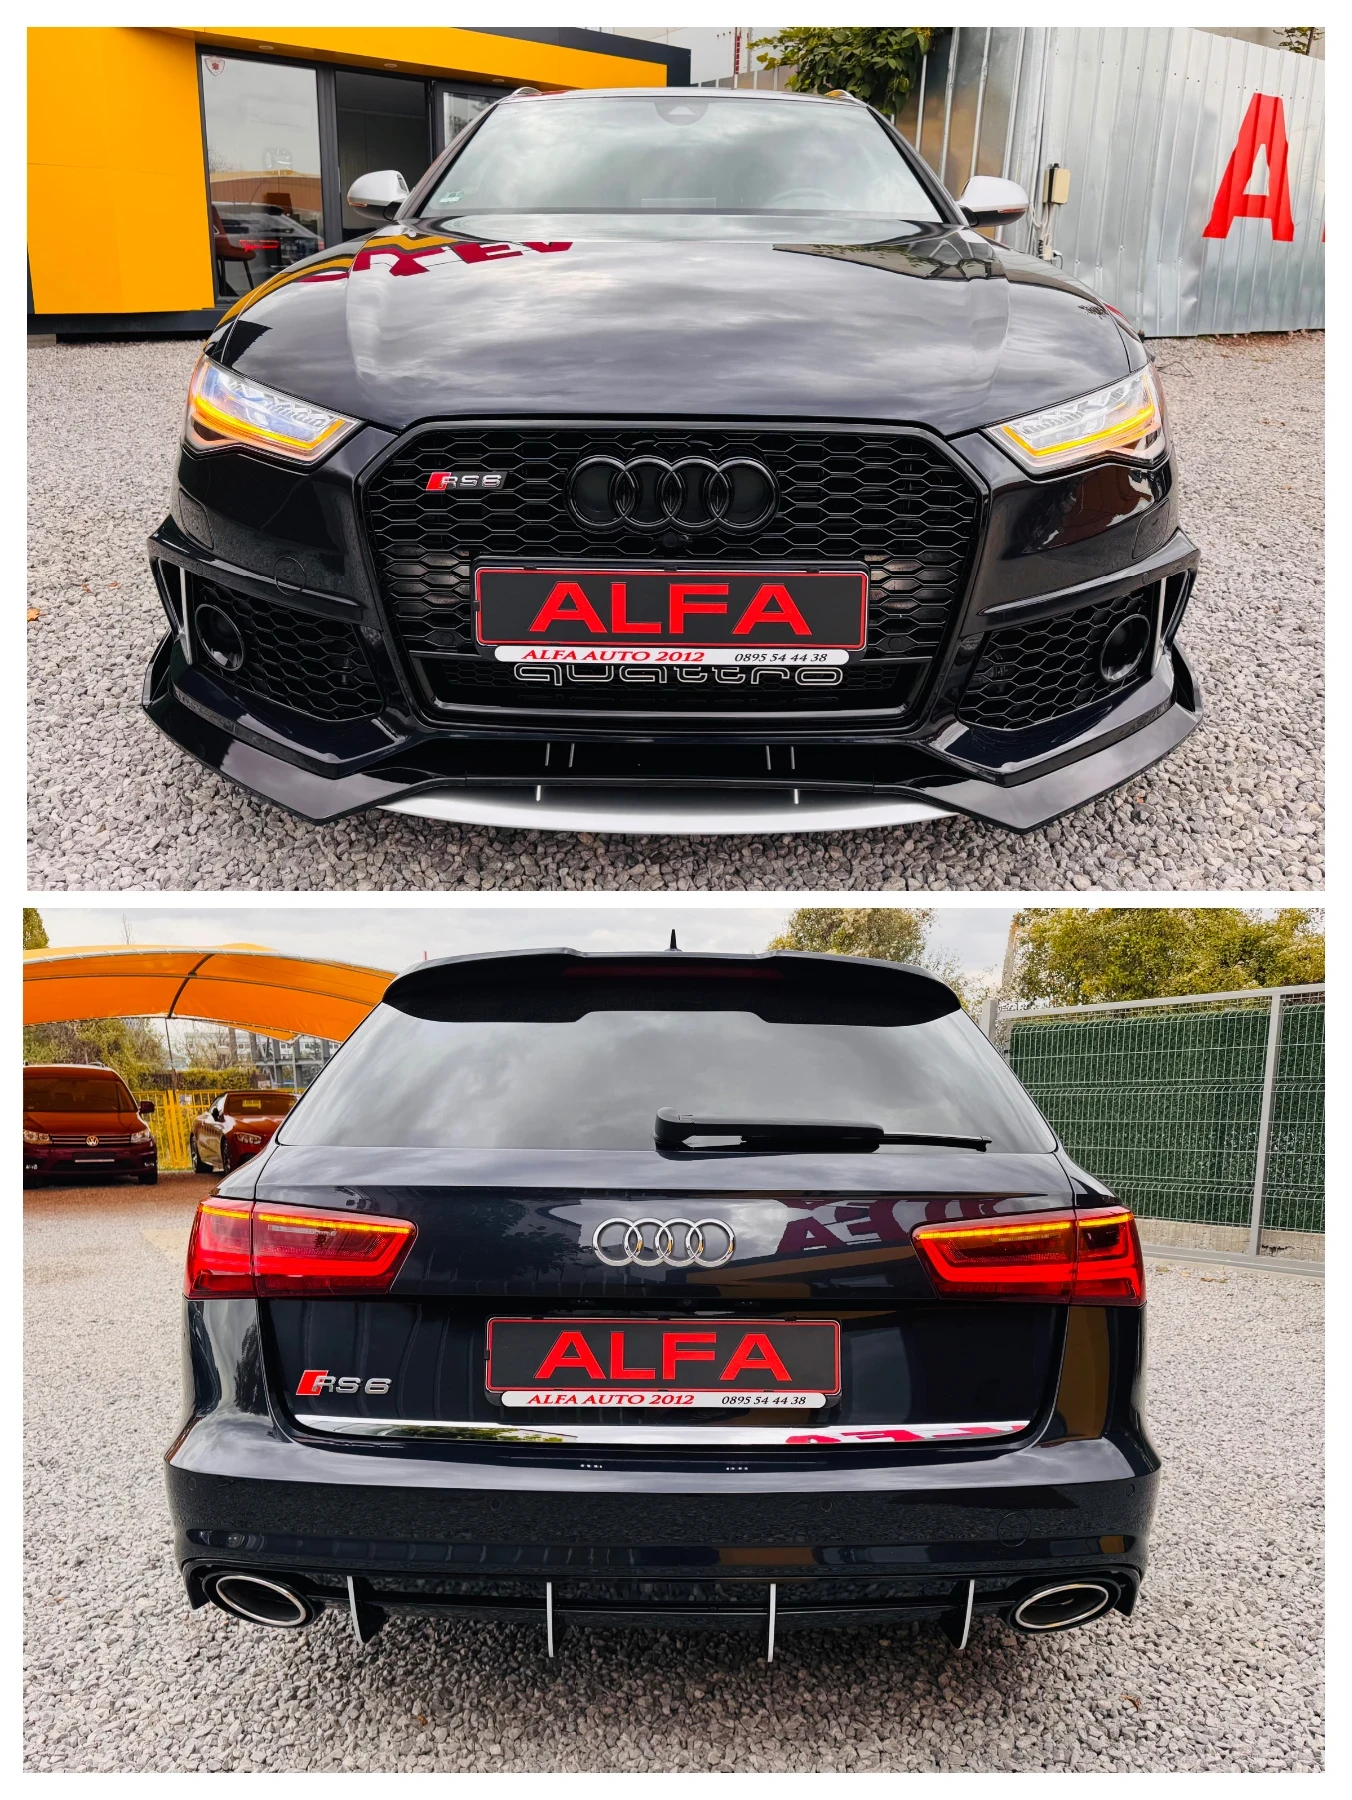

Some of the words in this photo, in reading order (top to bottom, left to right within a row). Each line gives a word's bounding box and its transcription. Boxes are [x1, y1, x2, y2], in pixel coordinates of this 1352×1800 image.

[1202, 87, 1325, 242] A
[432, 473, 502, 489] RS6
[528, 580, 813, 636] ALFA
[520, 649, 577, 661] ALFA
[581, 650, 651, 662] AUTO
[655, 650, 705, 662] 2012
[734, 653, 767, 662] 0895
[769, 653, 787, 662] 54
[790, 653, 808, 662] 44
[810, 653, 828, 662] 38
[513, 662, 844, 686] quattro
[533, 1329, 793, 1382] ALFA
[304, 1373, 393, 1395] RS6
[525, 1394, 579, 1405] ALFA
[581, 1394, 645, 1405] AUTO
[649, 1394, 695, 1405] 2012
[721, 1395, 752, 1405] 0895
[753, 1395, 769, 1405] 54
[772, 1395, 789, 1405] 44
[790, 1395, 807, 1405] 38
